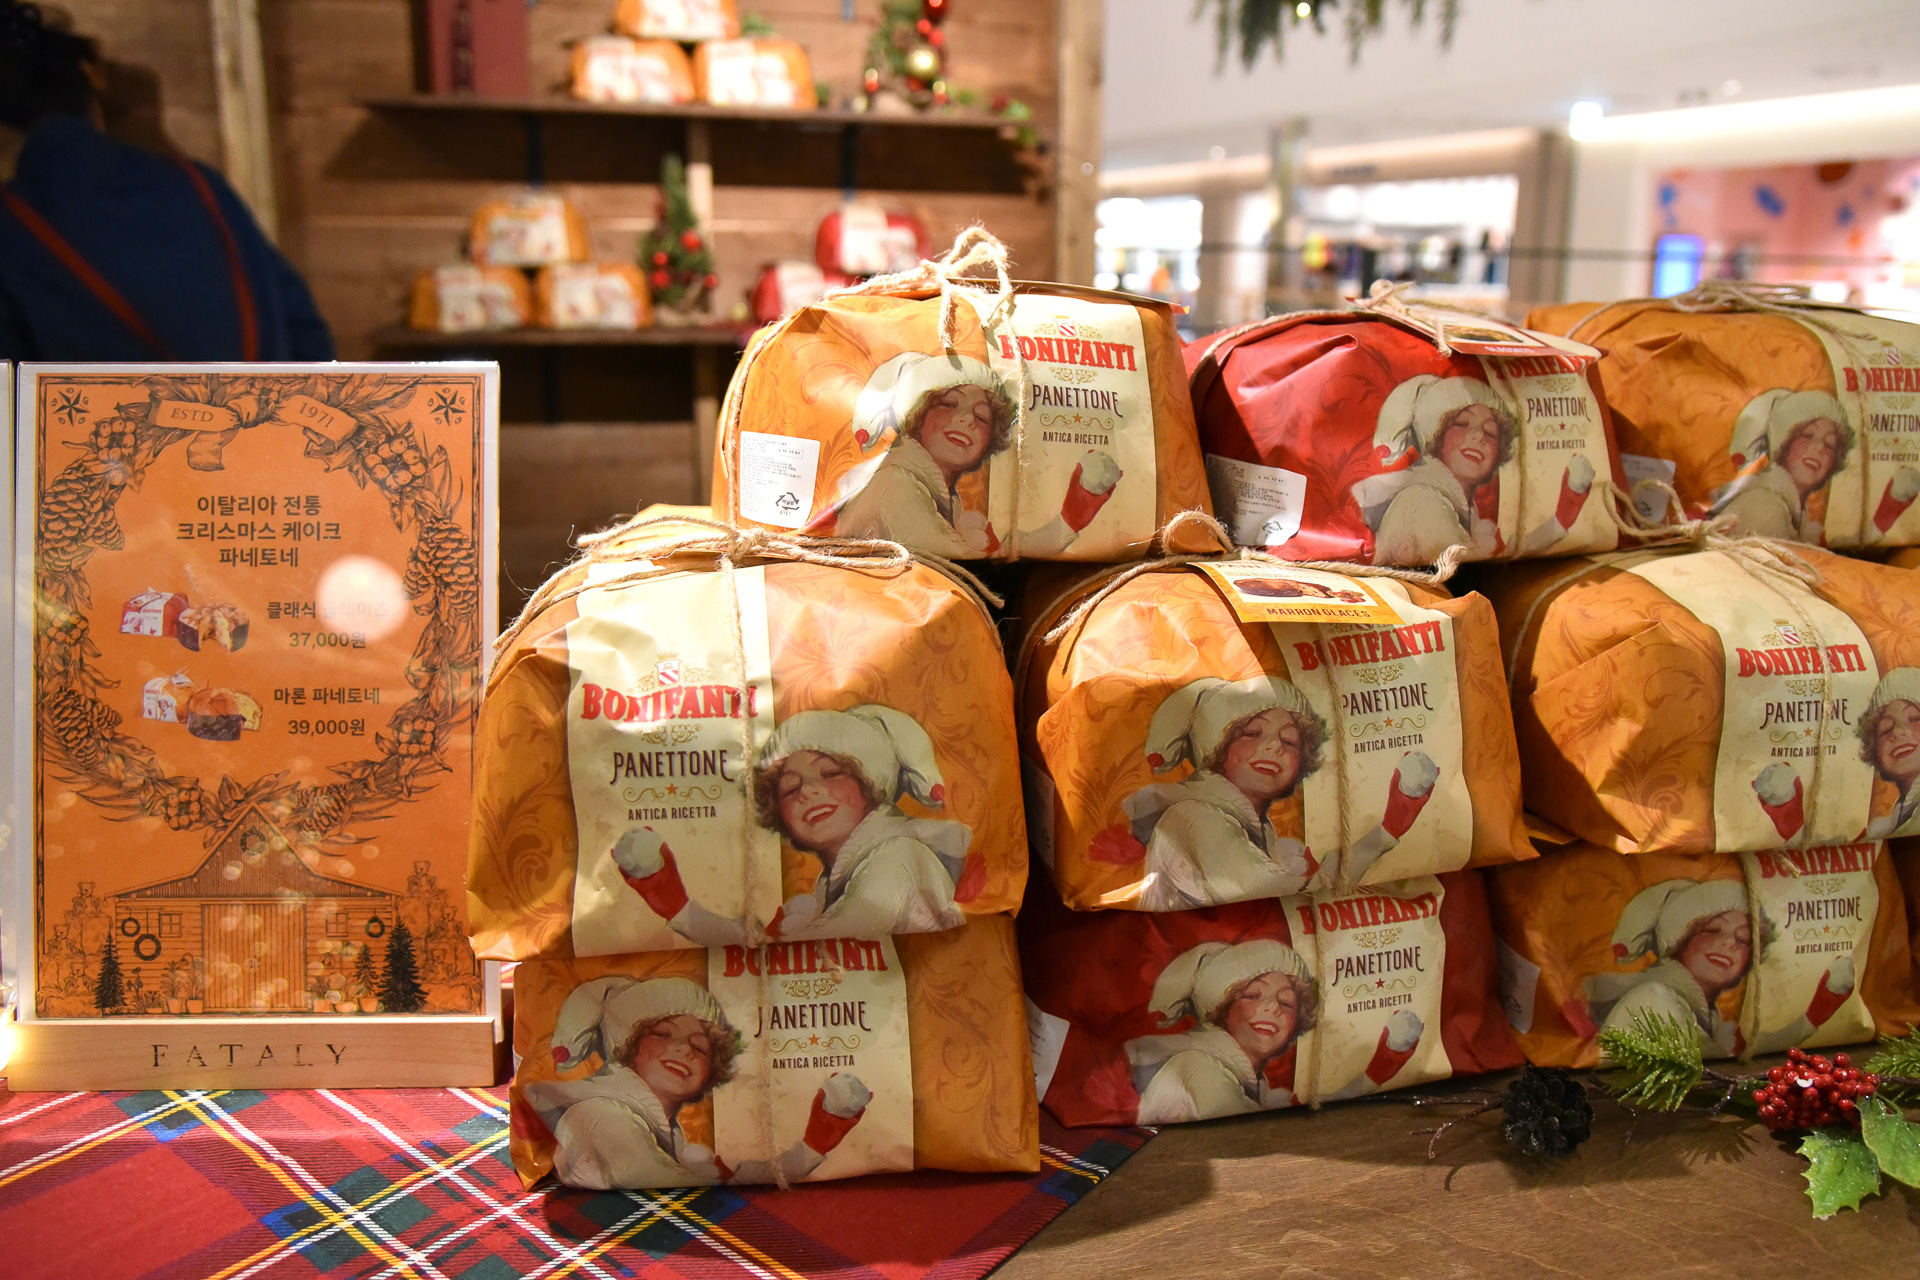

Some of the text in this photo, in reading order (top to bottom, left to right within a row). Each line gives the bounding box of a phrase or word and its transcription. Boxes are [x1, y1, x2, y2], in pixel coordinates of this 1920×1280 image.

[1028, 384, 1123, 418] PANETTONE
[170, 408, 214, 423] ESTD
[298, 402, 336, 428] 1971
[1042, 431, 1109, 445] ANTICA RICETTA
[1536, 439, 1586, 450] ANTICA RICETTA
[1871, 452, 1890, 461] NTICA
[197, 495, 322, 516] 이탈리아 전통
[176, 521, 342, 541] 크리스마스 케이크
[219, 547, 299, 567] 파네토네
[267, 601, 316, 619] 클래식
[1266, 608, 1321, 616] MARRON
[289, 632, 366, 649] 37,000원
[1736, 644, 1867, 677] BONIFANTI
[274, 687, 380, 705] 마론 파네토네
[581, 683, 758, 723] BONIFANTI
[1759, 698, 1851, 730] PANETTNE
[288, 718, 365, 737] 39,000원
[1354, 734, 1424, 754] ANTICA RICETTA
[1771, 747, 1803, 758] ANTICA
[610, 750, 734, 785] PANETTONE
[628, 806, 716, 821] ANTICA RICETTA
[1785, 896, 1862, 928] PANETTONE
[1795, 941, 1853, 955] ANTICA RICETTA
[1332, 946, 1424, 986] PANETTONE
[1347, 993, 1412, 1014] ANTICA RICETTA
[772, 1055, 855, 1069] ANTICA RICETTA
